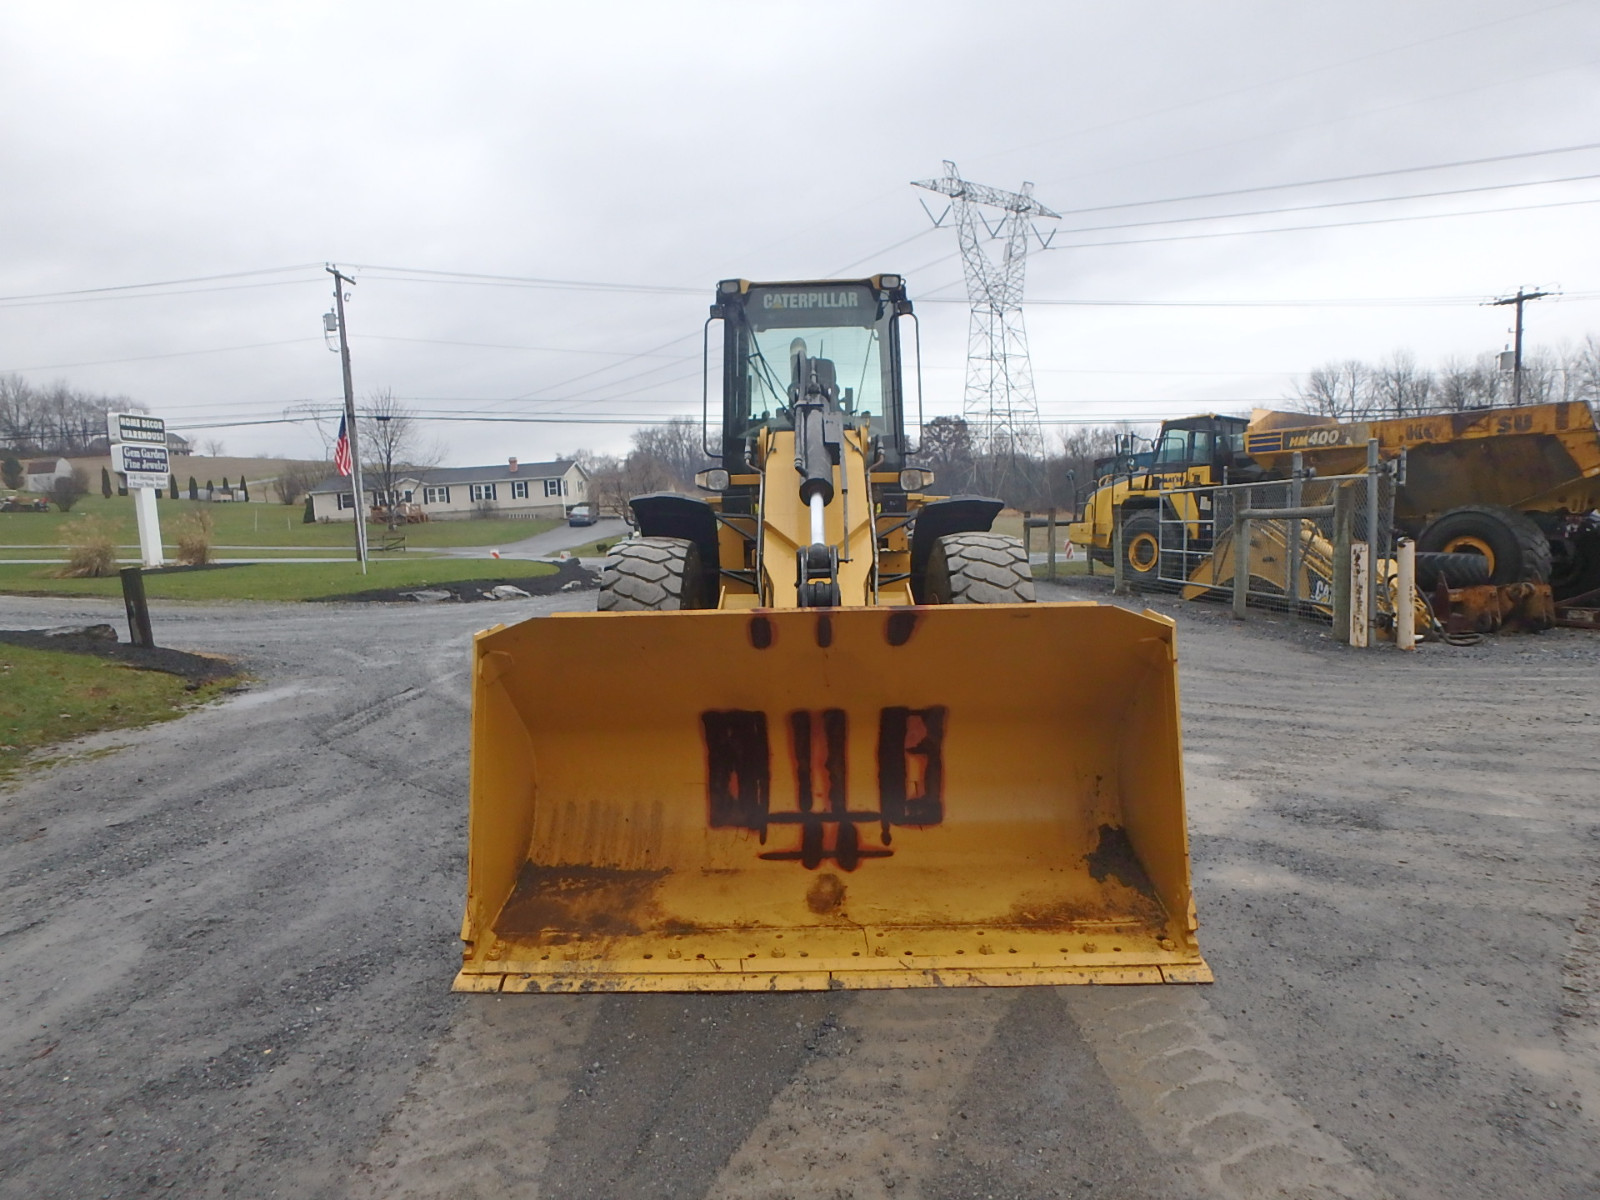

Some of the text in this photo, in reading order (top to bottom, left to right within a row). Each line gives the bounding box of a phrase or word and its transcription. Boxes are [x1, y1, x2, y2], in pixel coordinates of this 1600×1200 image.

[763, 292, 858, 309] CATERPILLAR
[120, 417, 164, 430] HOME DECOR
[121, 429, 164, 441] WAREHOUSE
[1289, 429, 1340, 447] HM400
[124, 447, 166, 460] Gem Garden
[124, 458, 168, 472] Fine Jewelry
[1314, 580, 1333, 604] CA
